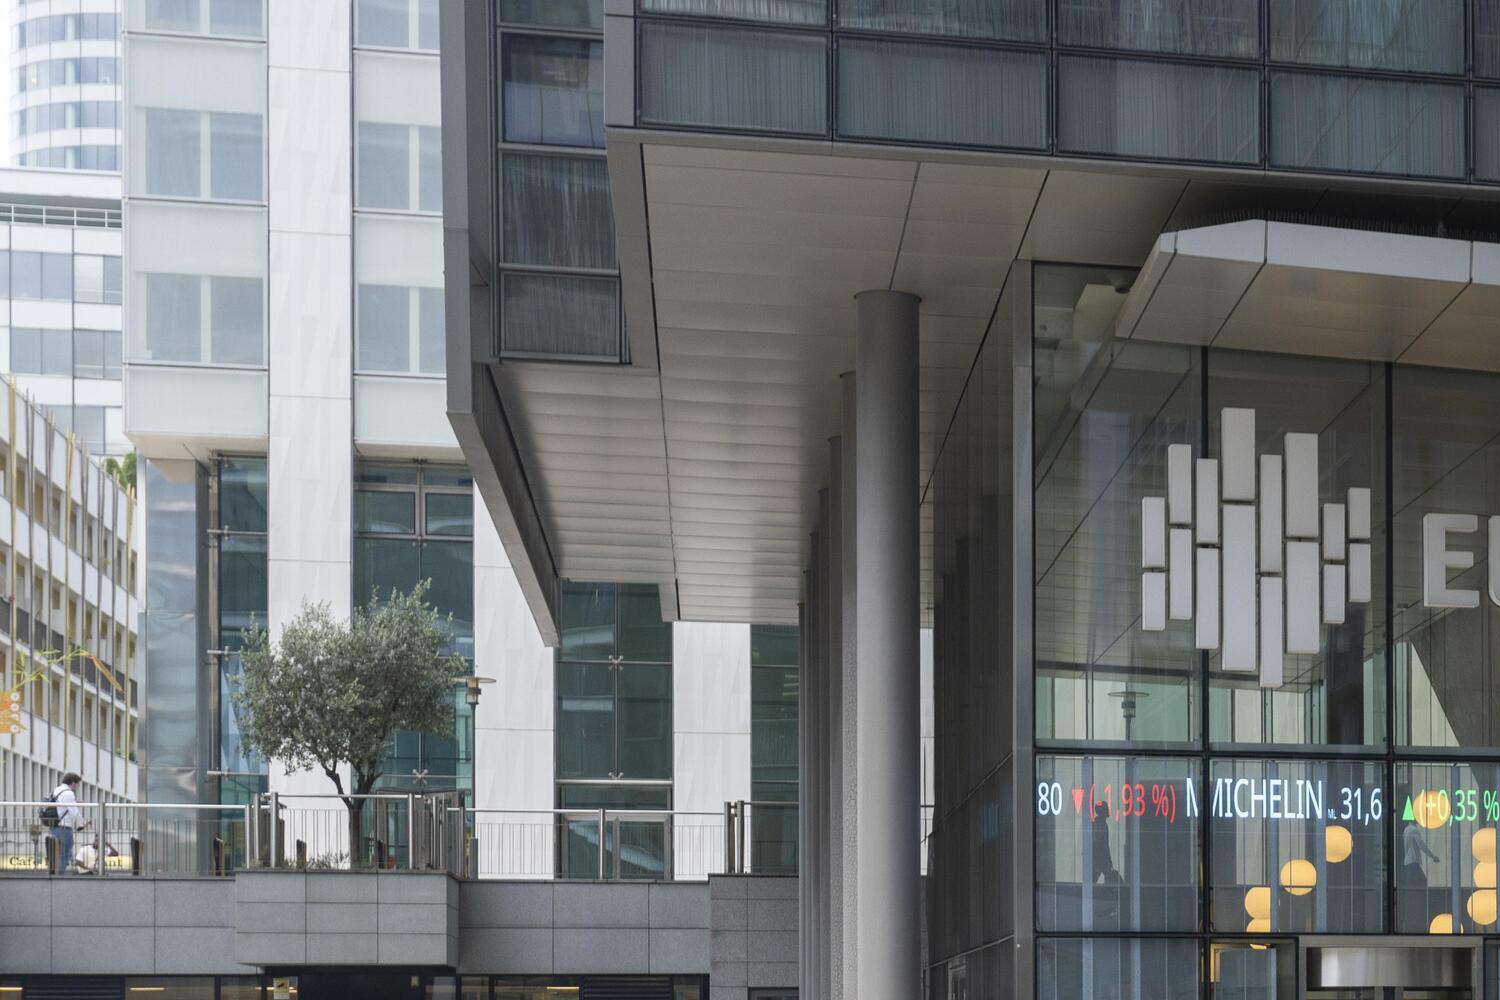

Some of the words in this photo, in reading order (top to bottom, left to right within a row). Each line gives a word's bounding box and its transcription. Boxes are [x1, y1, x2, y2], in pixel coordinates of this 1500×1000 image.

[1037, 782, 1062, 816] 80
[1152, 784, 1176, 825] %)
[1419, 789, 1478, 828] (+0,35
